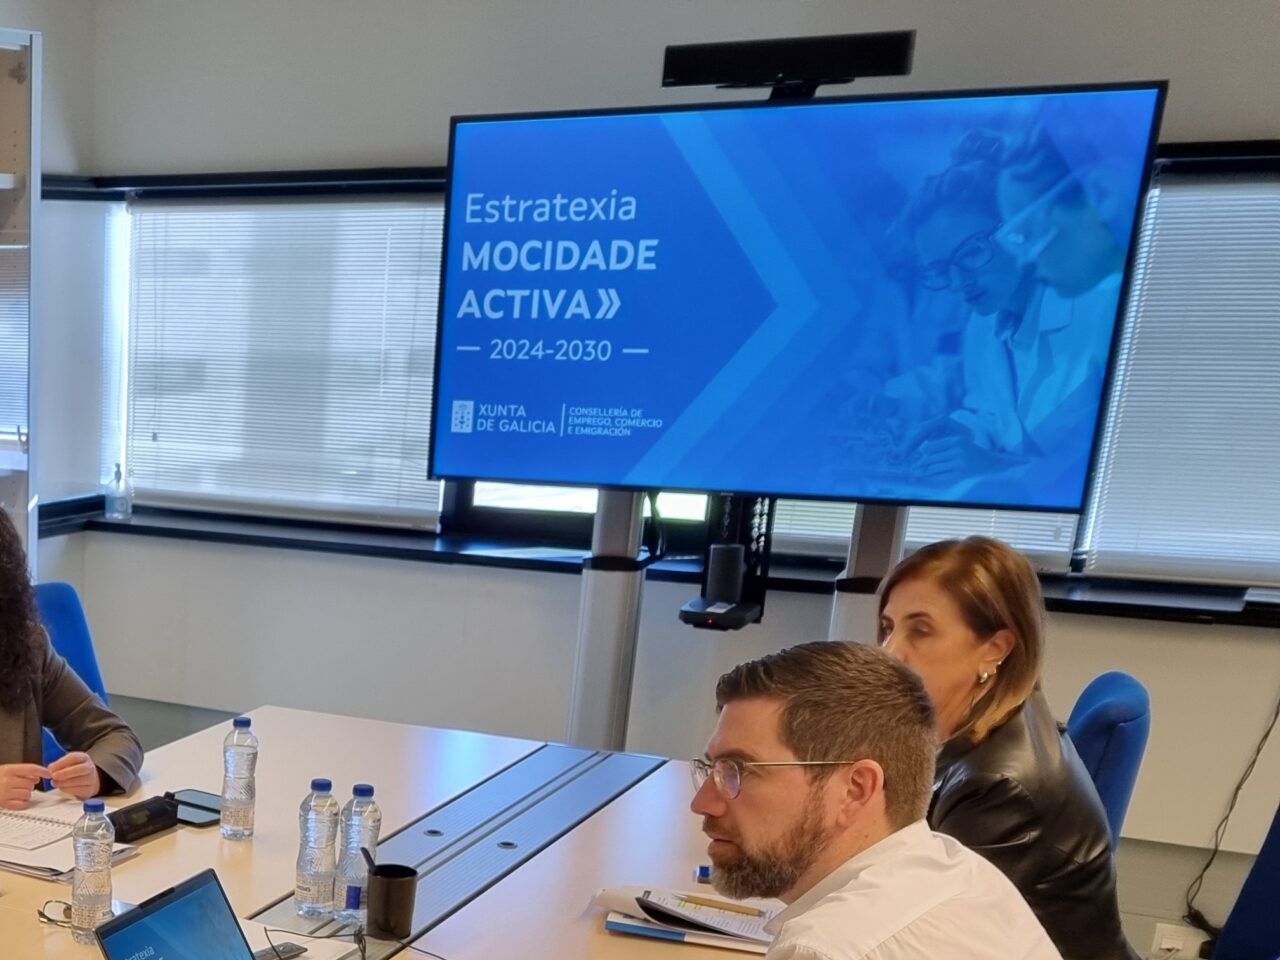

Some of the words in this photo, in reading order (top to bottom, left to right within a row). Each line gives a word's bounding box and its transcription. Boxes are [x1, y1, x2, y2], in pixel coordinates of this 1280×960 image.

[466, 189, 637, 223] Estratexia
[462, 239, 659, 271] MOCIDADE
[489, 339, 612, 361] 2024-2030
[479, 403, 526, 418] XUNTA
[569, 406, 628, 417] CONSELLERÍA
[630, 409, 643, 418] DE
[477, 418, 495, 431] DE
[499, 420, 556, 433] GALICIA
[614, 418, 663, 428] COMERCIO
[567, 426, 573, 435] E
[575, 426, 631, 437] EMIGRACIÓN
